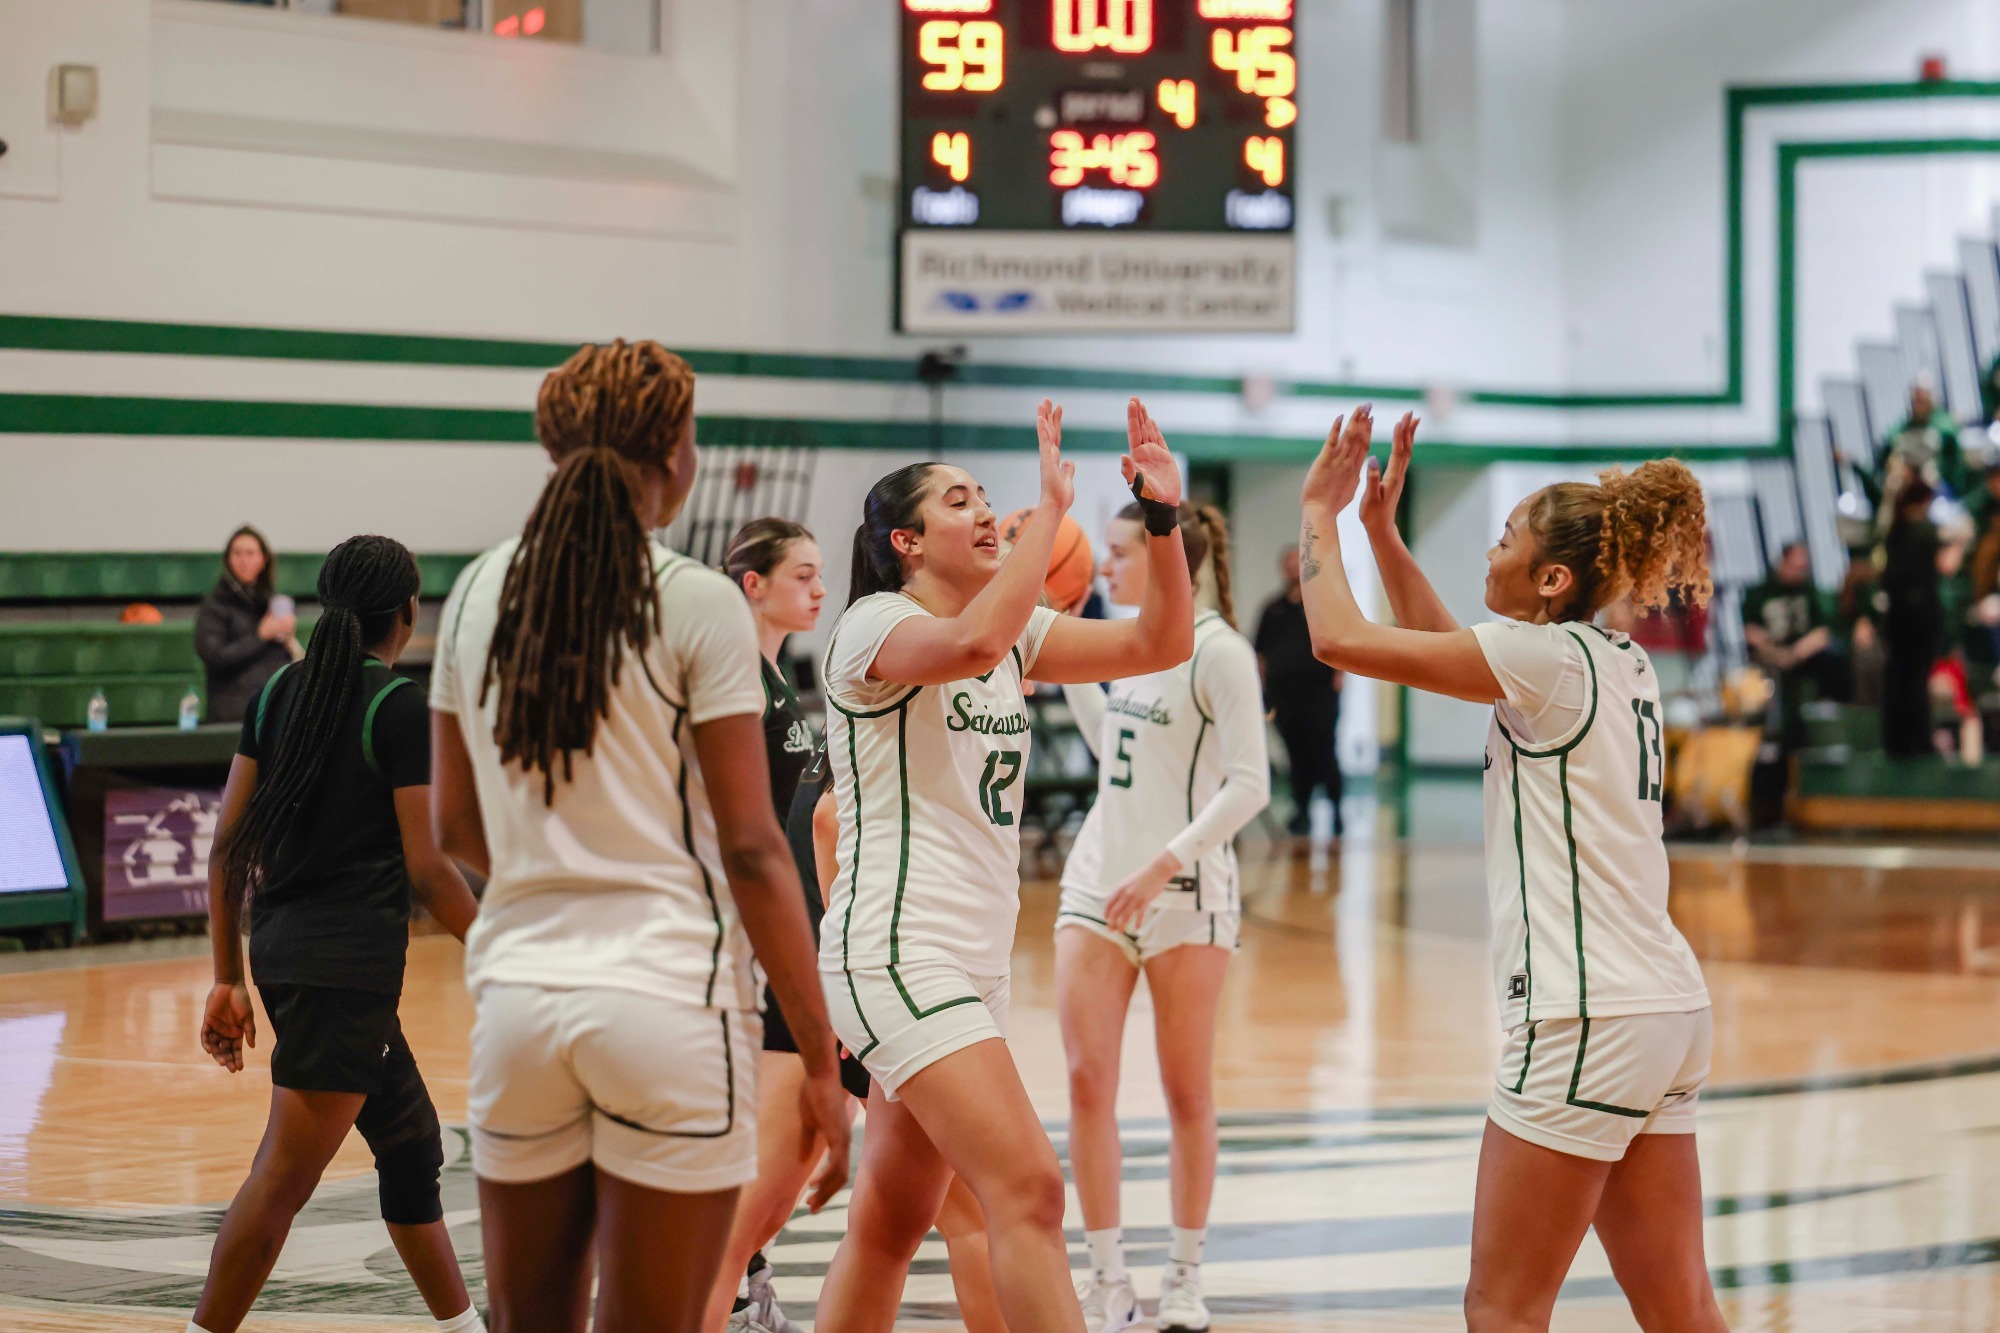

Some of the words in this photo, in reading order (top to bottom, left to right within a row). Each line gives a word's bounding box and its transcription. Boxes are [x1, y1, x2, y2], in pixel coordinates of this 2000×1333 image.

[919, 20, 1004, 92] 59
[1212, 26, 1296, 98] 45
[1158, 79, 1196, 129] 4
[932, 131, 969, 182] 4
[1245, 135, 1284, 187] 4
[918, 249, 1091, 283] Richmond
[1099, 250, 1281, 287] University
[1056, 290, 1166, 316] Medical
[1176, 290, 1280, 318] Center
[1110, 729, 1135, 789] 5
[1631, 698, 1661, 802] 13
[978, 750, 1022, 826] 12
